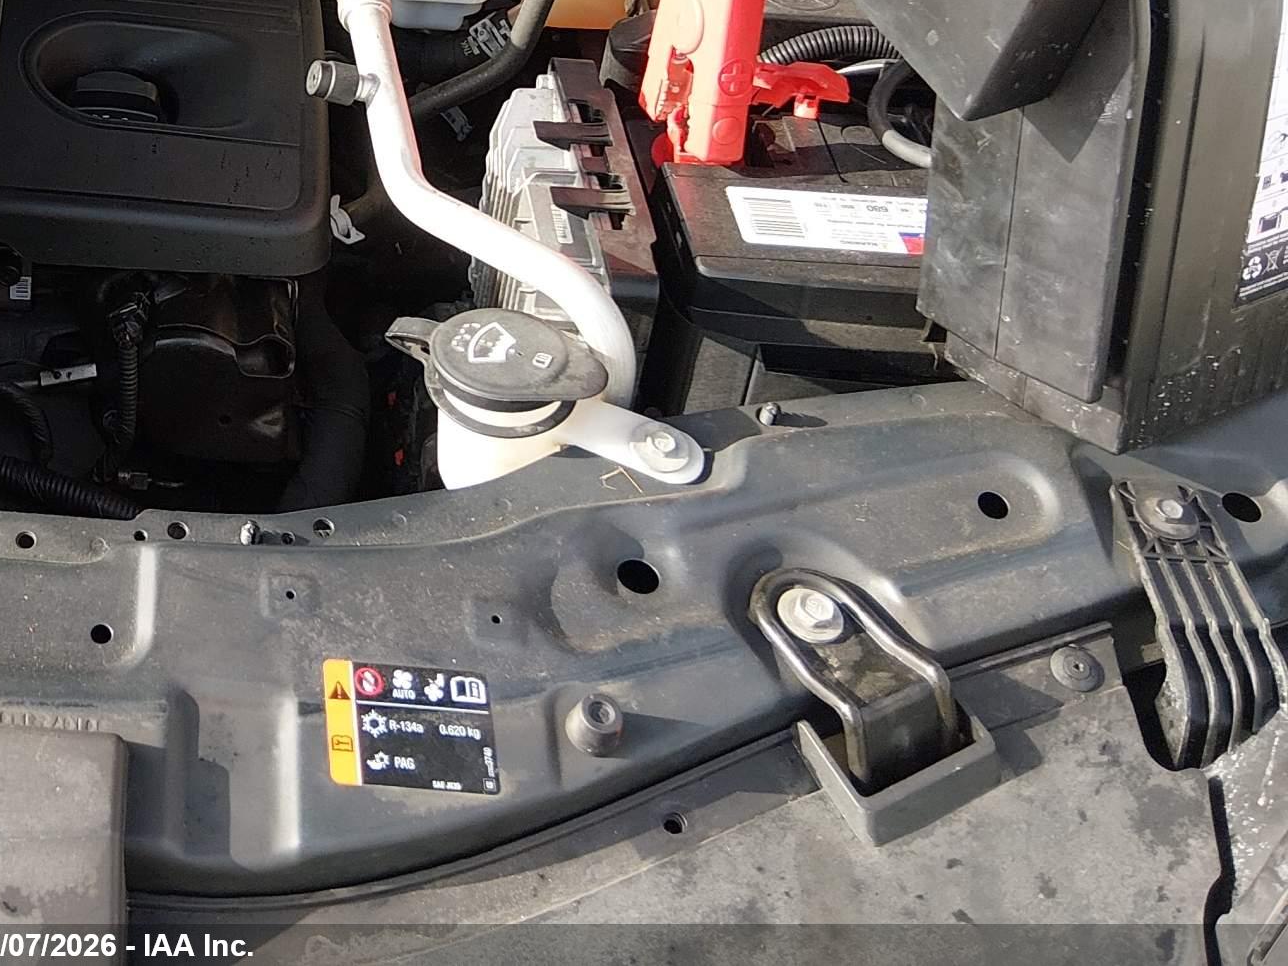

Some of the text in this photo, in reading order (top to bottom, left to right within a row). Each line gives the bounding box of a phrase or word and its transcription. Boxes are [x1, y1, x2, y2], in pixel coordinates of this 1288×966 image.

[392, 689, 416, 700] AUTO
[389, 720, 482, 741] R-134a 0.620 kg
[393, 756, 416, 770] PAG
